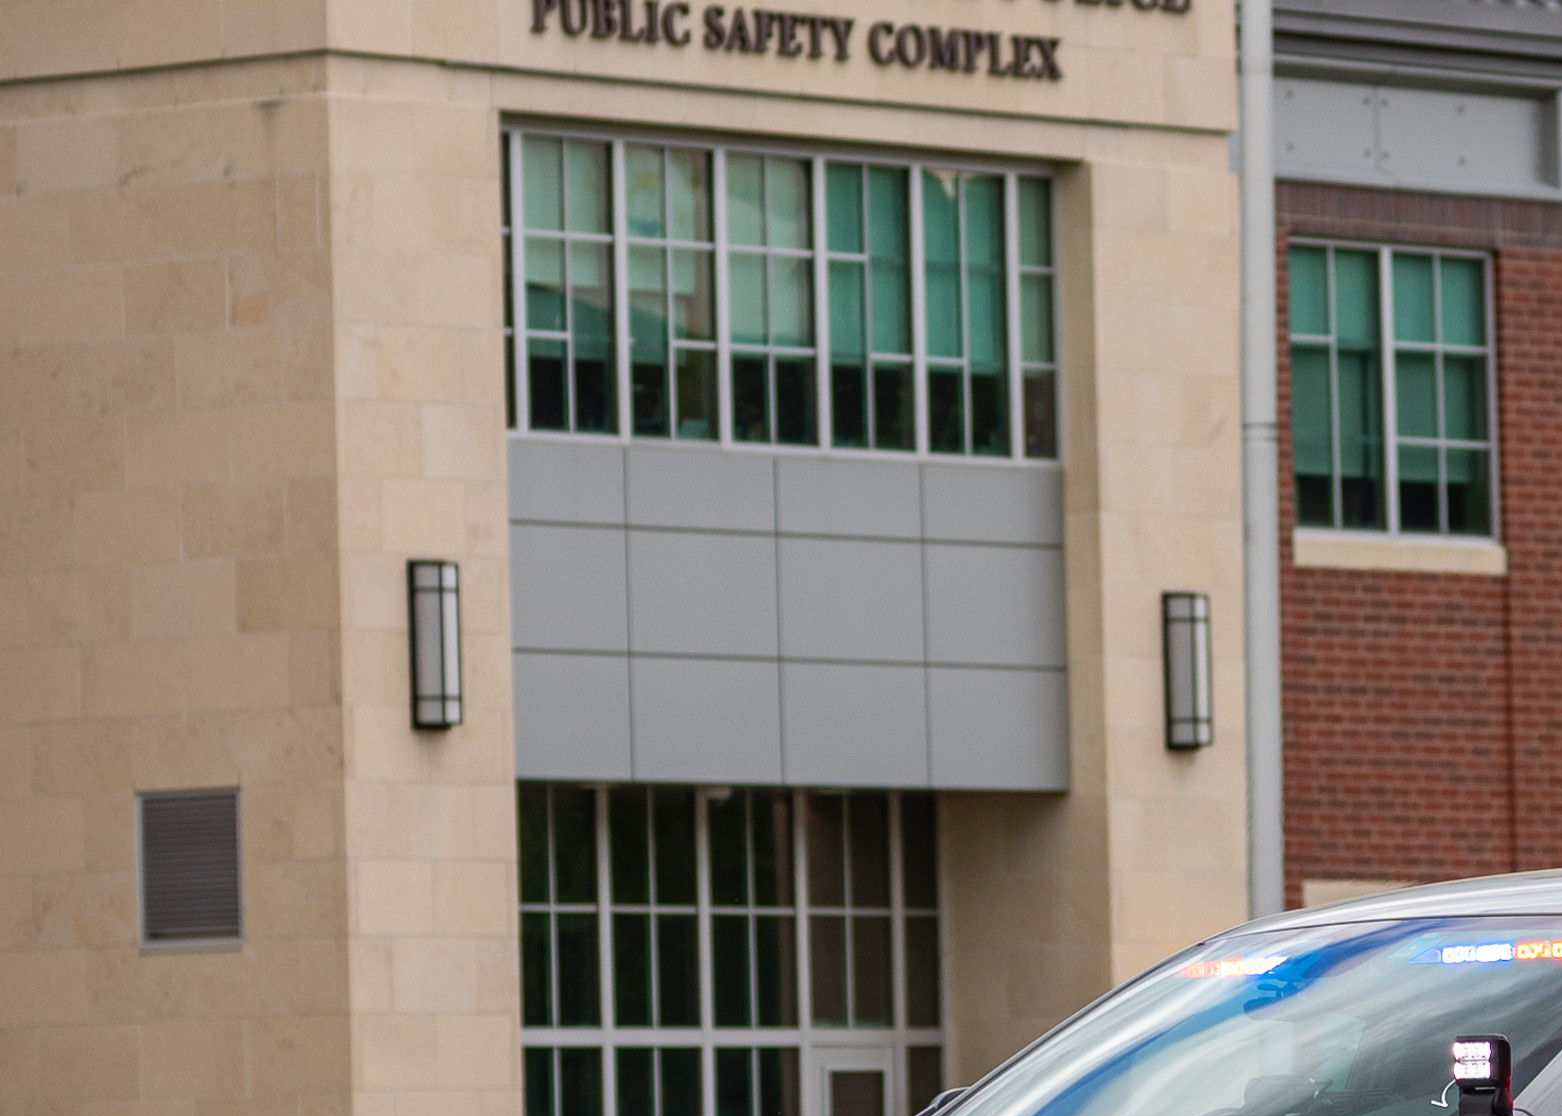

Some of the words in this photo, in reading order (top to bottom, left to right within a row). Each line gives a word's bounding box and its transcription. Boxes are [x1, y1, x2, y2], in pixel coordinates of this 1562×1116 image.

[530, 0, 691, 48] PUBLIC
[702, 5, 855, 62] SAFETY
[867, 21, 1063, 80] COMPLEX
